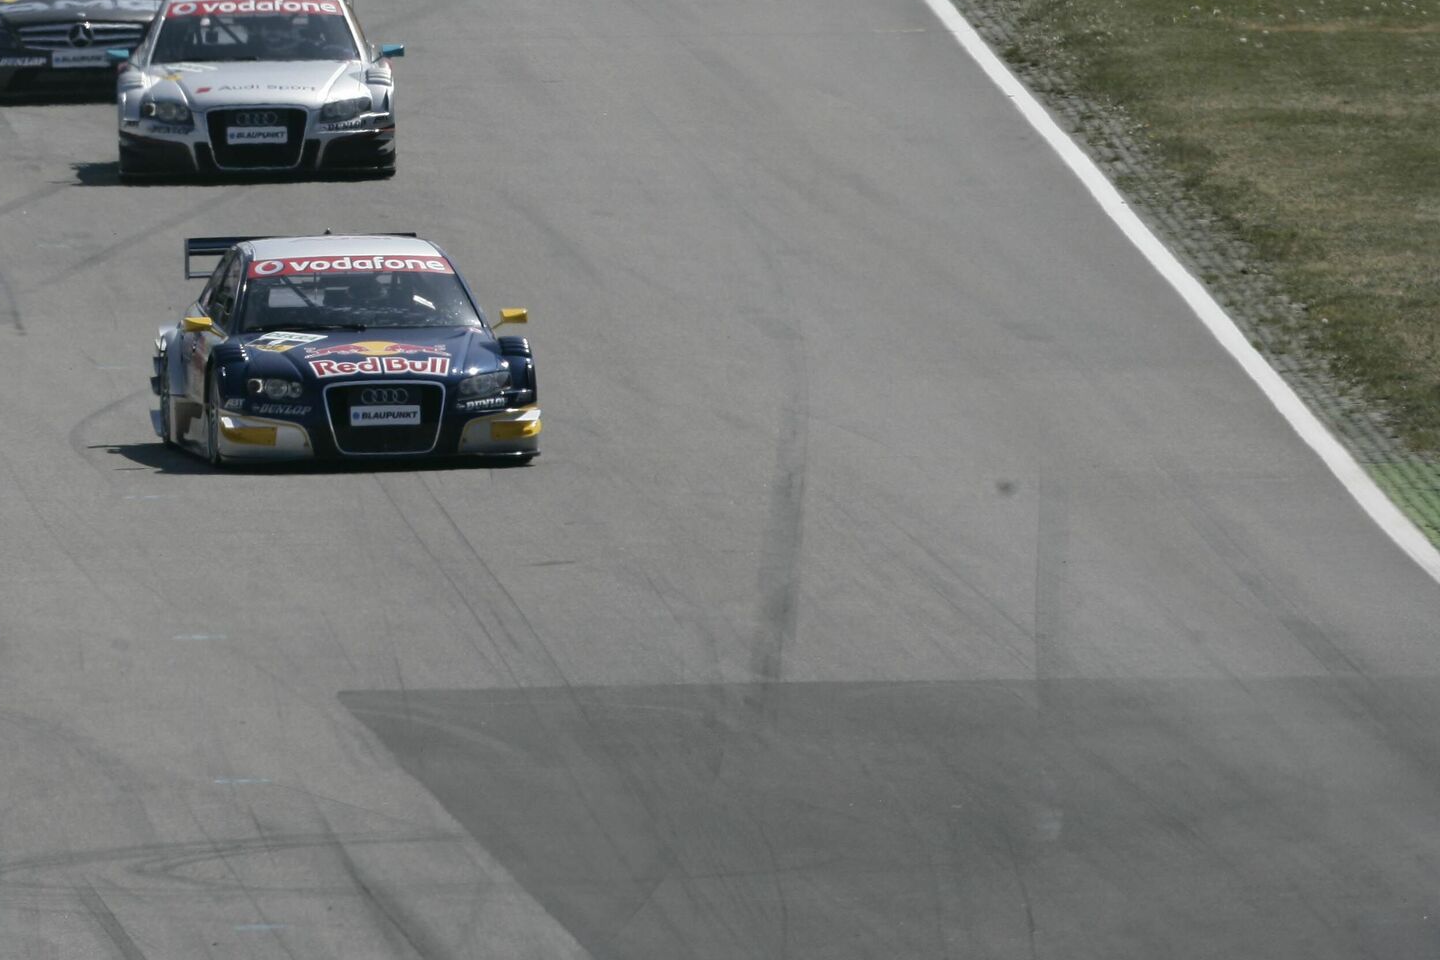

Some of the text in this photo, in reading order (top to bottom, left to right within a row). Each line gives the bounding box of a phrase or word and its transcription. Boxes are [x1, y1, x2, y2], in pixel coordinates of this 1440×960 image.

[202, 0, 338, 14] vodafone
[236, 131, 286, 140] BLAUPUNKT
[295, 256, 445, 272] vodafone
[309, 357, 449, 378] Red Bull
[260, 404, 312, 416] DUNLOP
[362, 411, 418, 420] BLAUPUNKT
